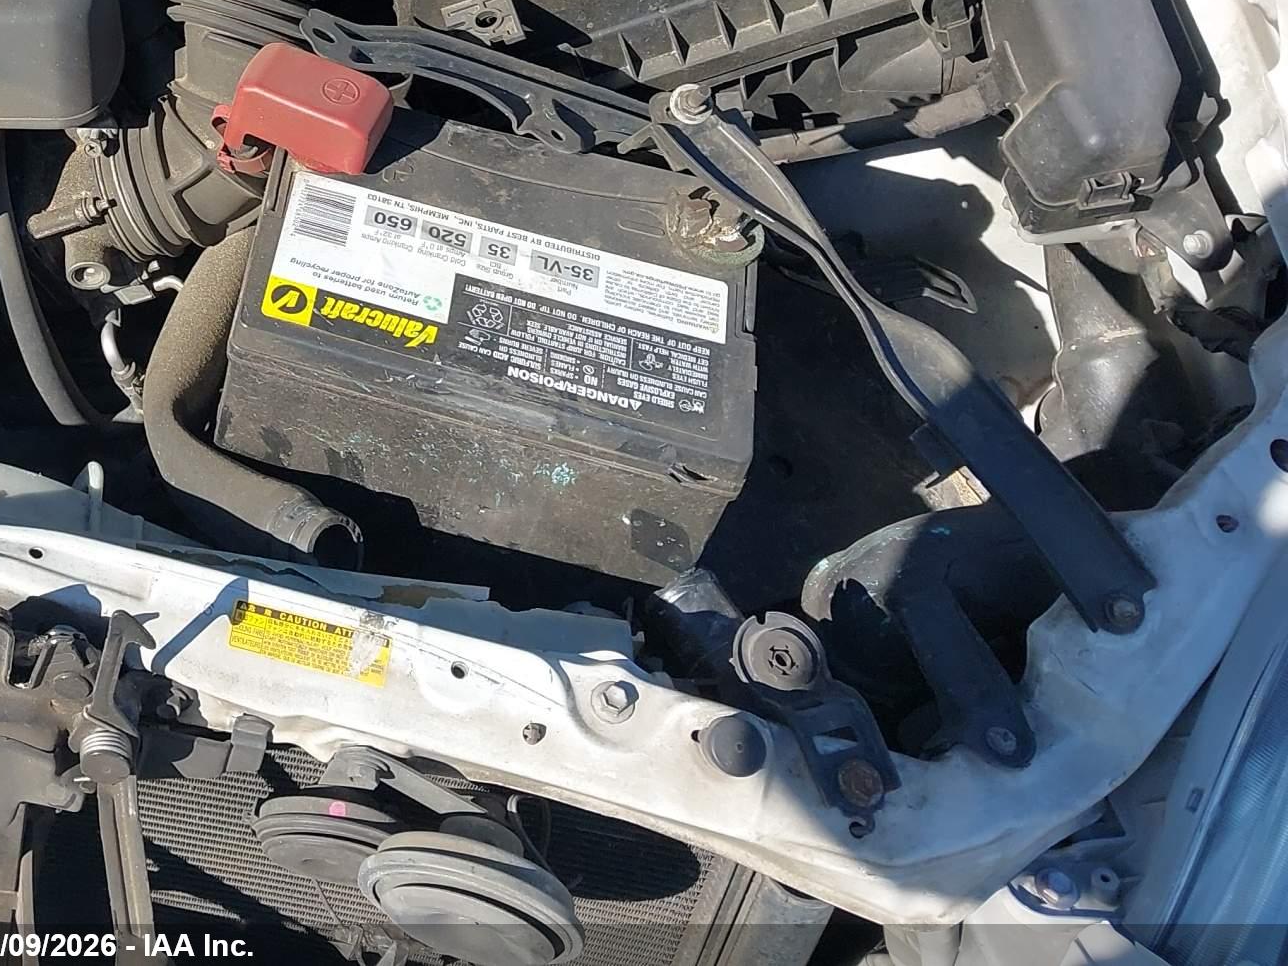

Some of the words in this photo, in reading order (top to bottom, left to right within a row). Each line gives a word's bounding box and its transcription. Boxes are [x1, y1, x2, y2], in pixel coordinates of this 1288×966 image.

[366, 193, 392, 205] 38103
[393, 200, 405, 208] TN
[406, 203, 449, 220] MEMPHIS,
[373, 210, 412, 231] 650
[360, 232, 381, 243] Amps
[427, 225, 466, 247] 520
[506, 230, 528, 241] BEST
[529, 236, 542, 245] BY
[381, 237, 413, 252] Cranking
[486, 242, 511, 259] 35
[543, 240, 600, 260] DISTRIBUTED
[416, 247, 448, 262] Cranking
[445, 247, 465, 258] Amps
[288, 256, 329, 273] recycling
[450, 256, 466, 266] Cold
[535, 255, 593, 281] 35-VL
[311, 270, 320, 279] to
[330, 268, 360, 282] proper
[323, 274, 362, 291] batteries
[361, 276, 375, 286] for
[549, 277, 578, 289] Number
[363, 284, 386, 297] used
[377, 281, 420, 299] AutoZone
[556, 286, 571, 295] Part
[388, 291, 419, 306] Return
[494, 292, 512, 303] OPEN
[512, 297, 526, 306] NOT
[526, 300, 536, 309] DO
[551, 307, 565, 317] NOT
[566, 311, 577, 320] DO
[320, 295, 439, 347] Valucraft
[510, 328, 534, 341] FOLLOW
[617, 325, 626, 333] OF
[627, 327, 647, 339] REACH
[553, 333, 576, 345] VEHICLE
[574, 332, 586, 340] NOT
[602, 332, 627, 344] SERVICE
[648, 333, 664, 344] THE
[457, 341, 478, 352] CAUSE
[520, 342, 543, 354] SEVERE
[666, 338, 676, 347] OF
[677, 341, 691, 351] OUT
[478, 346, 491, 356] CAN
[492, 350, 509, 361] ACID
[508, 347, 542, 361] BLINDNESS
[583, 348, 595, 357] FOR
[653, 346, 669, 355] HELP
[669, 350, 695, 363] MEDICAL
[692, 345, 710, 356] KEEP
[509, 355, 541, 369] SULFURIC
[550, 359, 574, 371] FLAMES
[696, 357, 708, 366] GET
[549, 366, 573, 378] SPARKS
[668, 364, 708, 380] IMMEDIATELY
[691, 363, 708, 373] WITH
[583, 374, 598, 386] NO
[616, 377, 638, 389] GASES
[639, 374, 672, 389] BLINDNESS
[671, 372, 686, 382] EYES
[687, 376, 707, 387] FLUSH
[506, 365, 629, 408] DANGER/POISON
[639, 383, 675, 399] EXPLOSIVE
[673, 384, 693, 395] CAUSE
[633, 390, 650, 401] EYES
[694, 389, 706, 398] CAN
[651, 395, 674, 408] SHIELD
[279, 613, 328, 632] CAUTION
